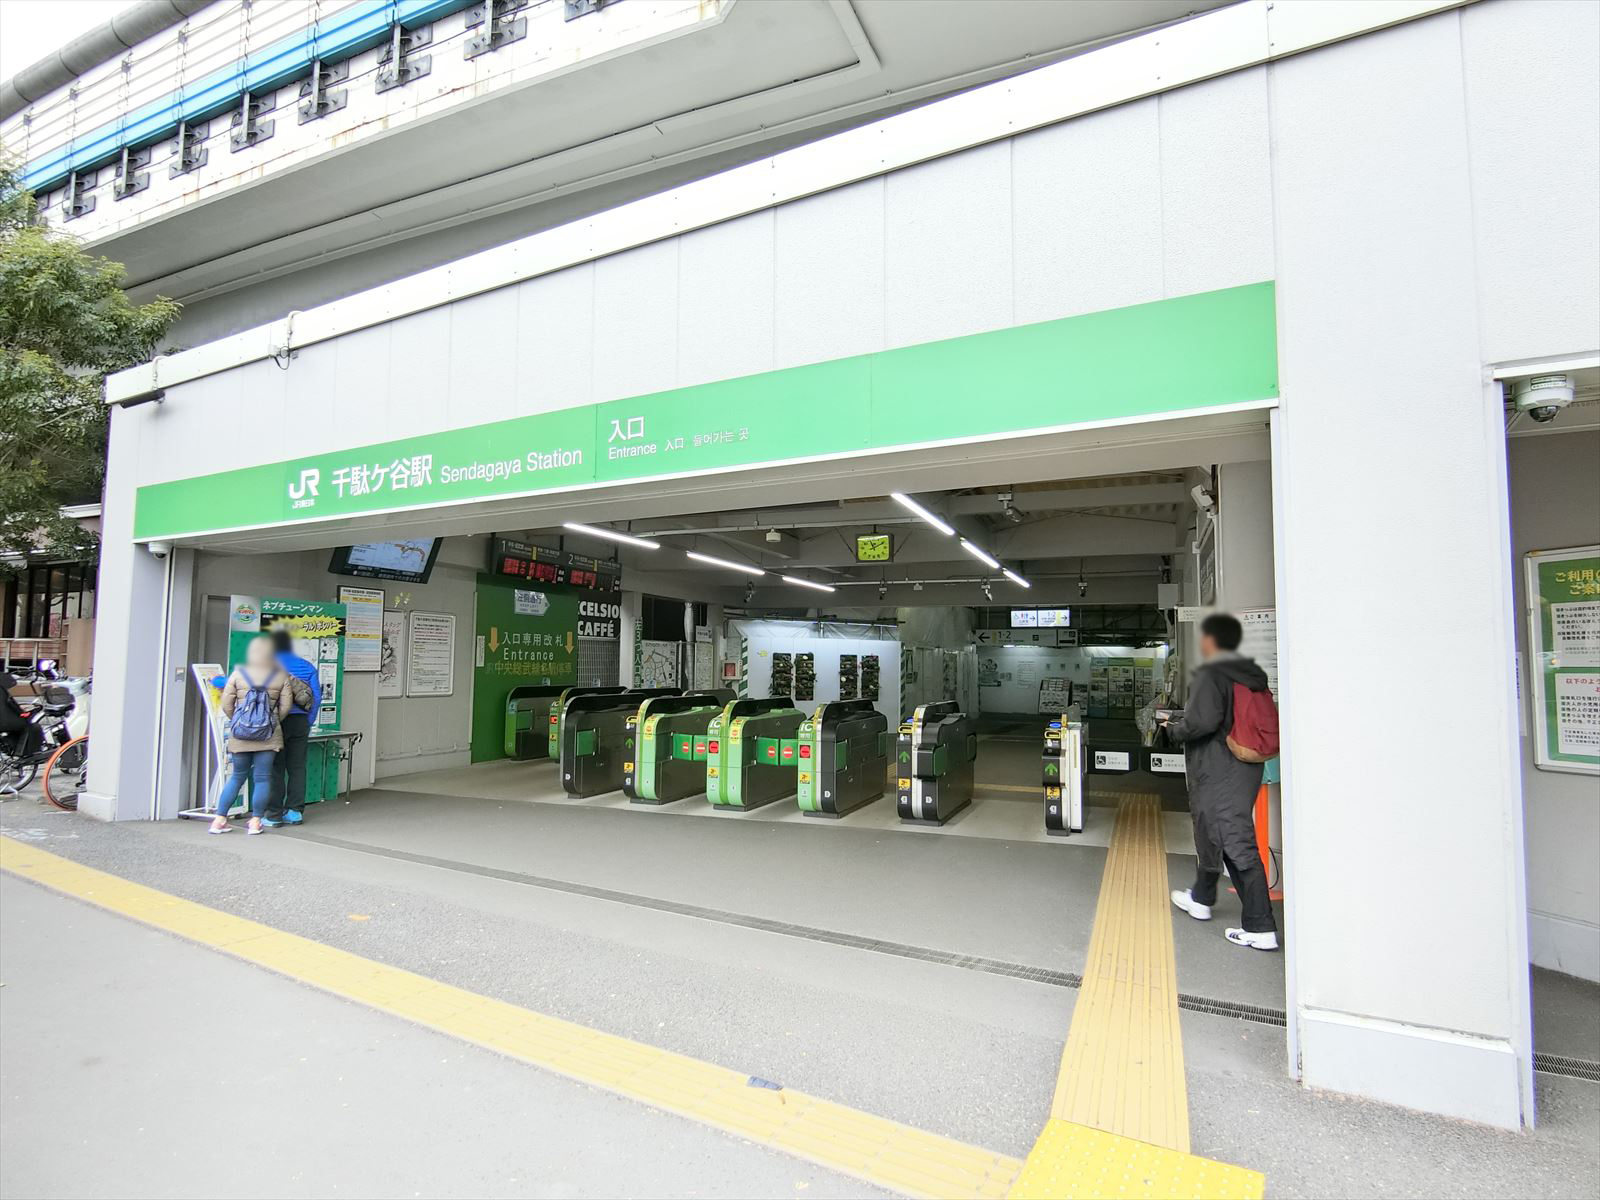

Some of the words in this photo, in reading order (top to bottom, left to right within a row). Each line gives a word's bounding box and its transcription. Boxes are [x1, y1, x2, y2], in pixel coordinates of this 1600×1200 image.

[608, 416, 645, 443] 入口
[608, 442, 657, 460] Entrance
[664, 437, 684, 452] 入口
[441, 458, 522, 485] Sendagaya
[527, 447, 583, 471] Station
[289, 468, 320, 499] JR
[577, 600, 621, 619] CELSIO
[577, 620, 615, 637] CAFFÉ
[502, 631, 564, 647] 入口専用改札
[503, 647, 554, 661] Entrance
[800, 723, 813, 732] IC
